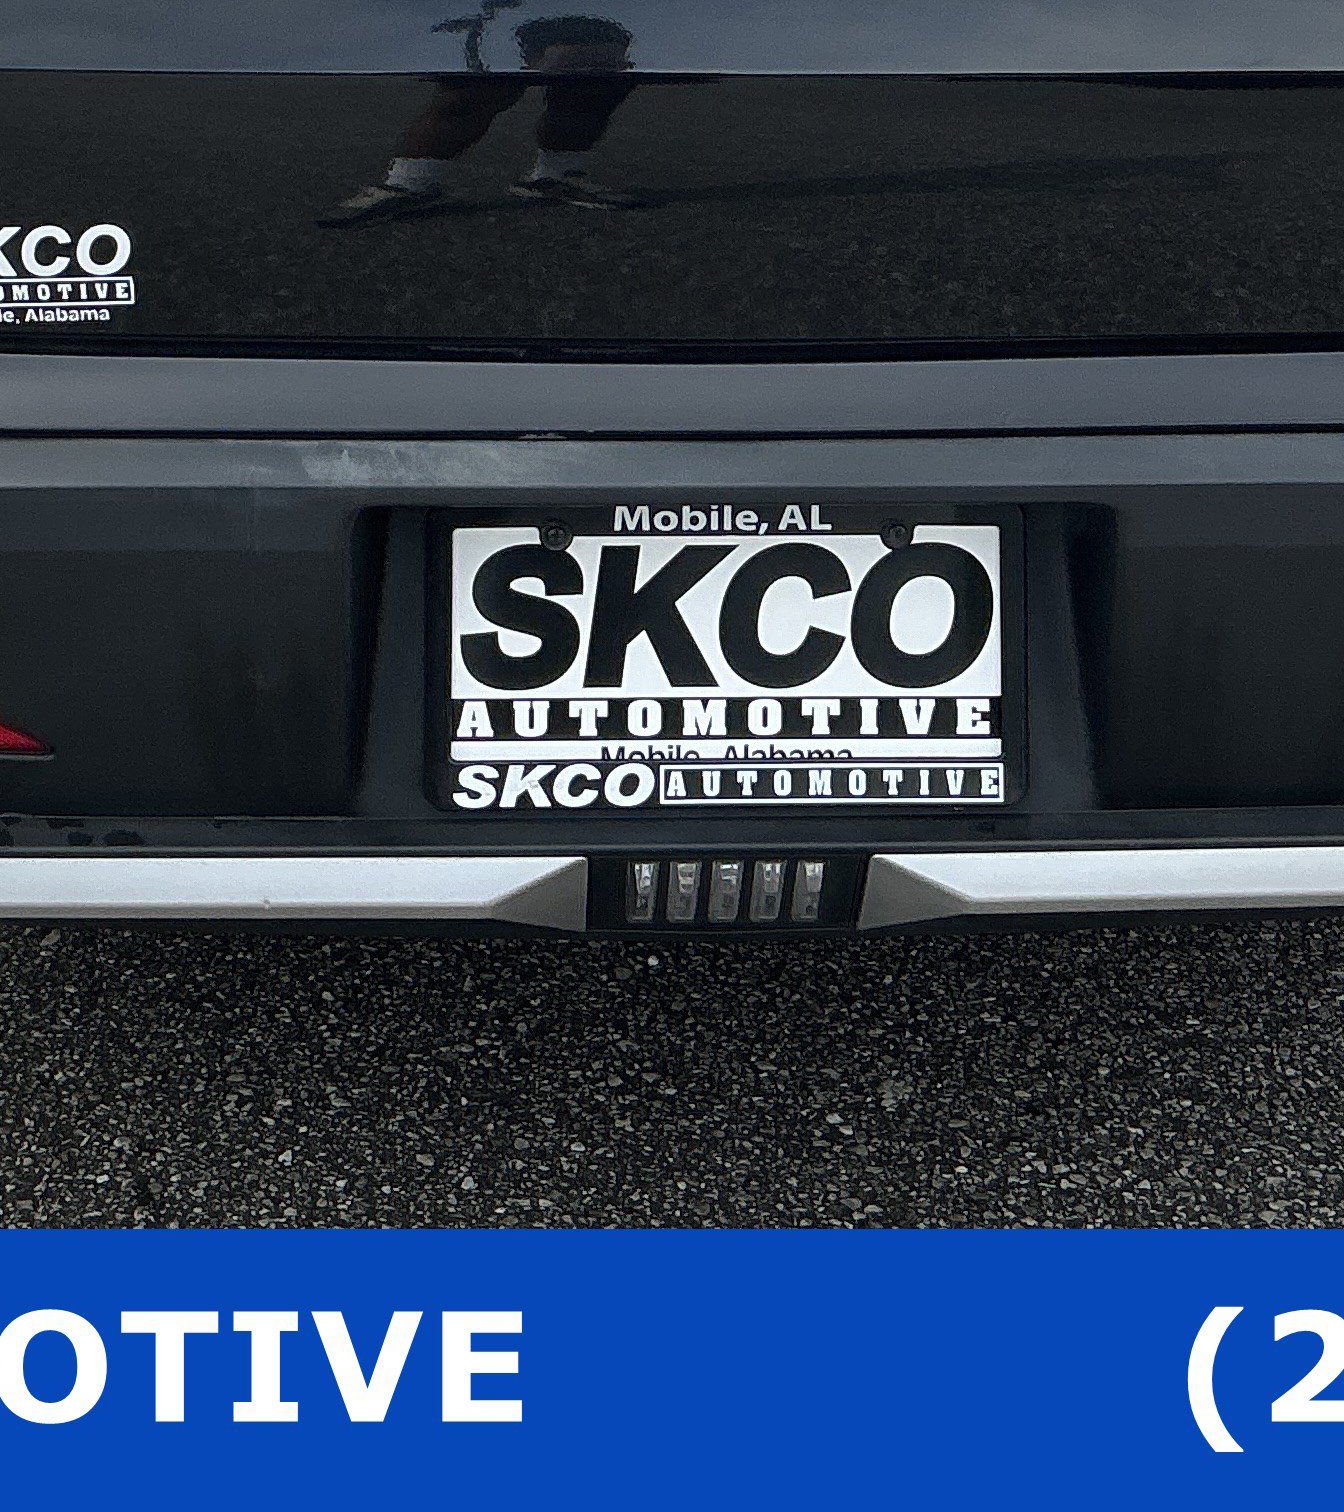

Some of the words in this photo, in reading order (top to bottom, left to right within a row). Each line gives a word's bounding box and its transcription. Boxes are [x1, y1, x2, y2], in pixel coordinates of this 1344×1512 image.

[25, 307, 111, 323] Alabama
[613, 504, 768, 535] Mobile,
[777, 504, 833, 531] AL
[459, 541, 994, 690] SKCO
[456, 697, 991, 738] AUTOMOTIVE
[452, 762, 657, 809] SKCO
[667, 769, 999, 797] AUTOMOTIVE
